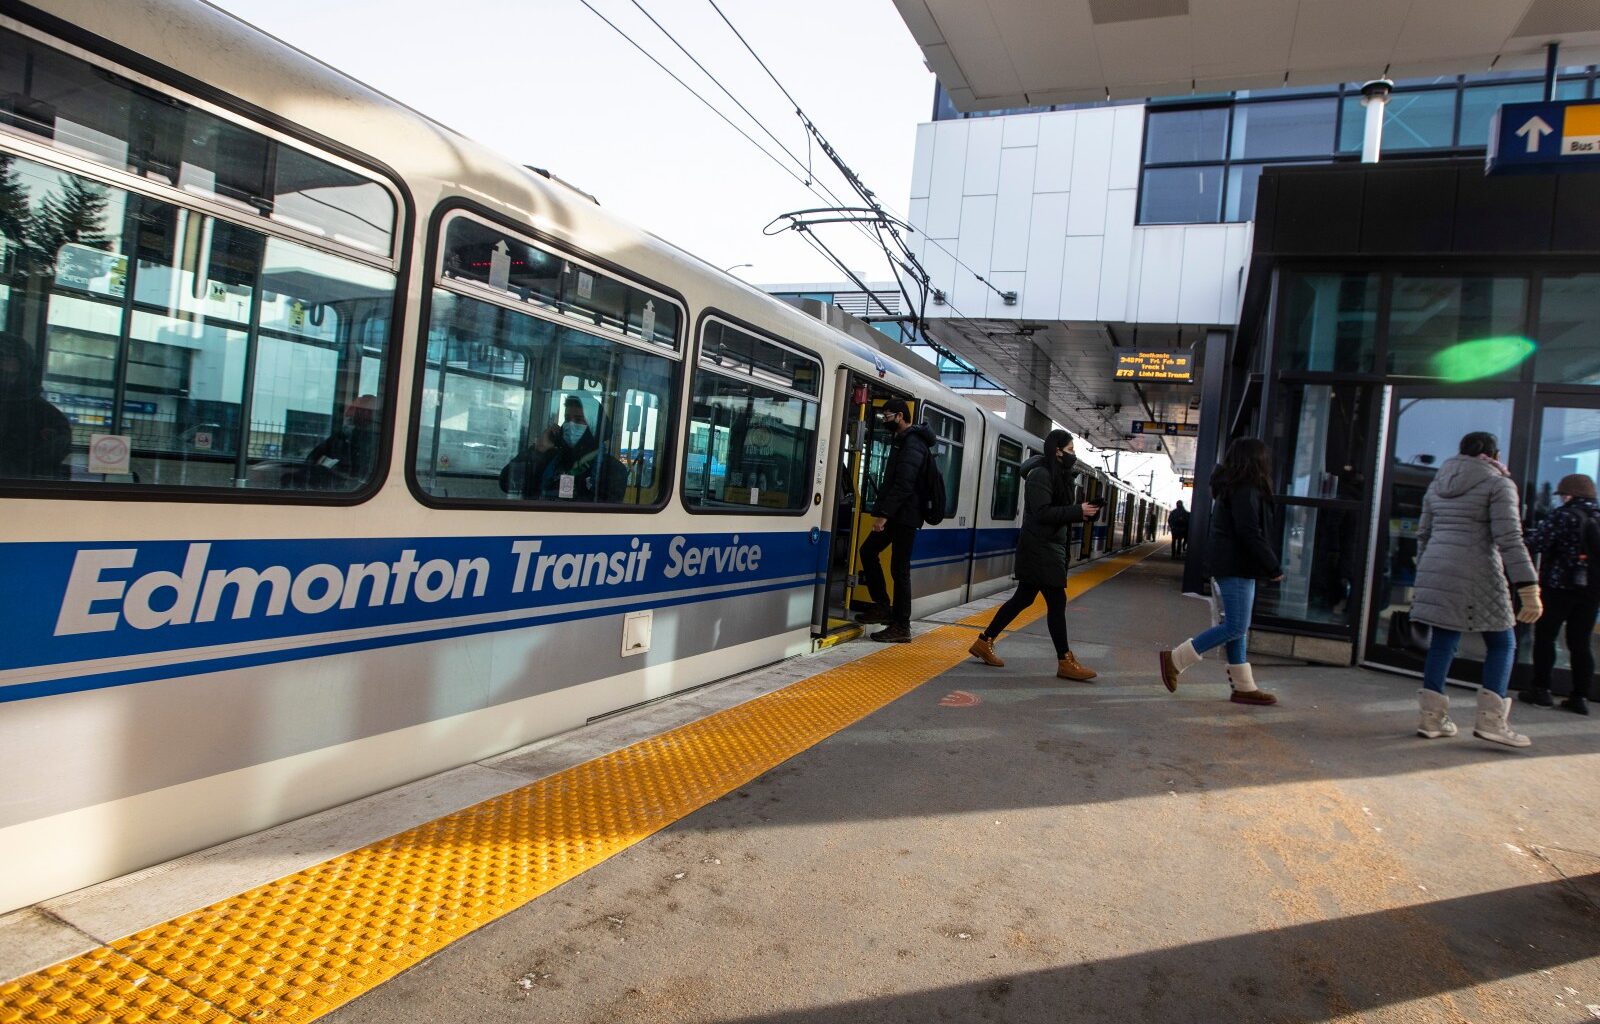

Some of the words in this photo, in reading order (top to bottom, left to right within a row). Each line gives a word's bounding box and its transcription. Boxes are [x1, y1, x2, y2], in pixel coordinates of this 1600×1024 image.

[1570, 141, 1594, 151] Bus
[54, 543, 489, 636] Edmonton
[510, 537, 652, 594] Transit
[664, 535, 762, 579] Service
